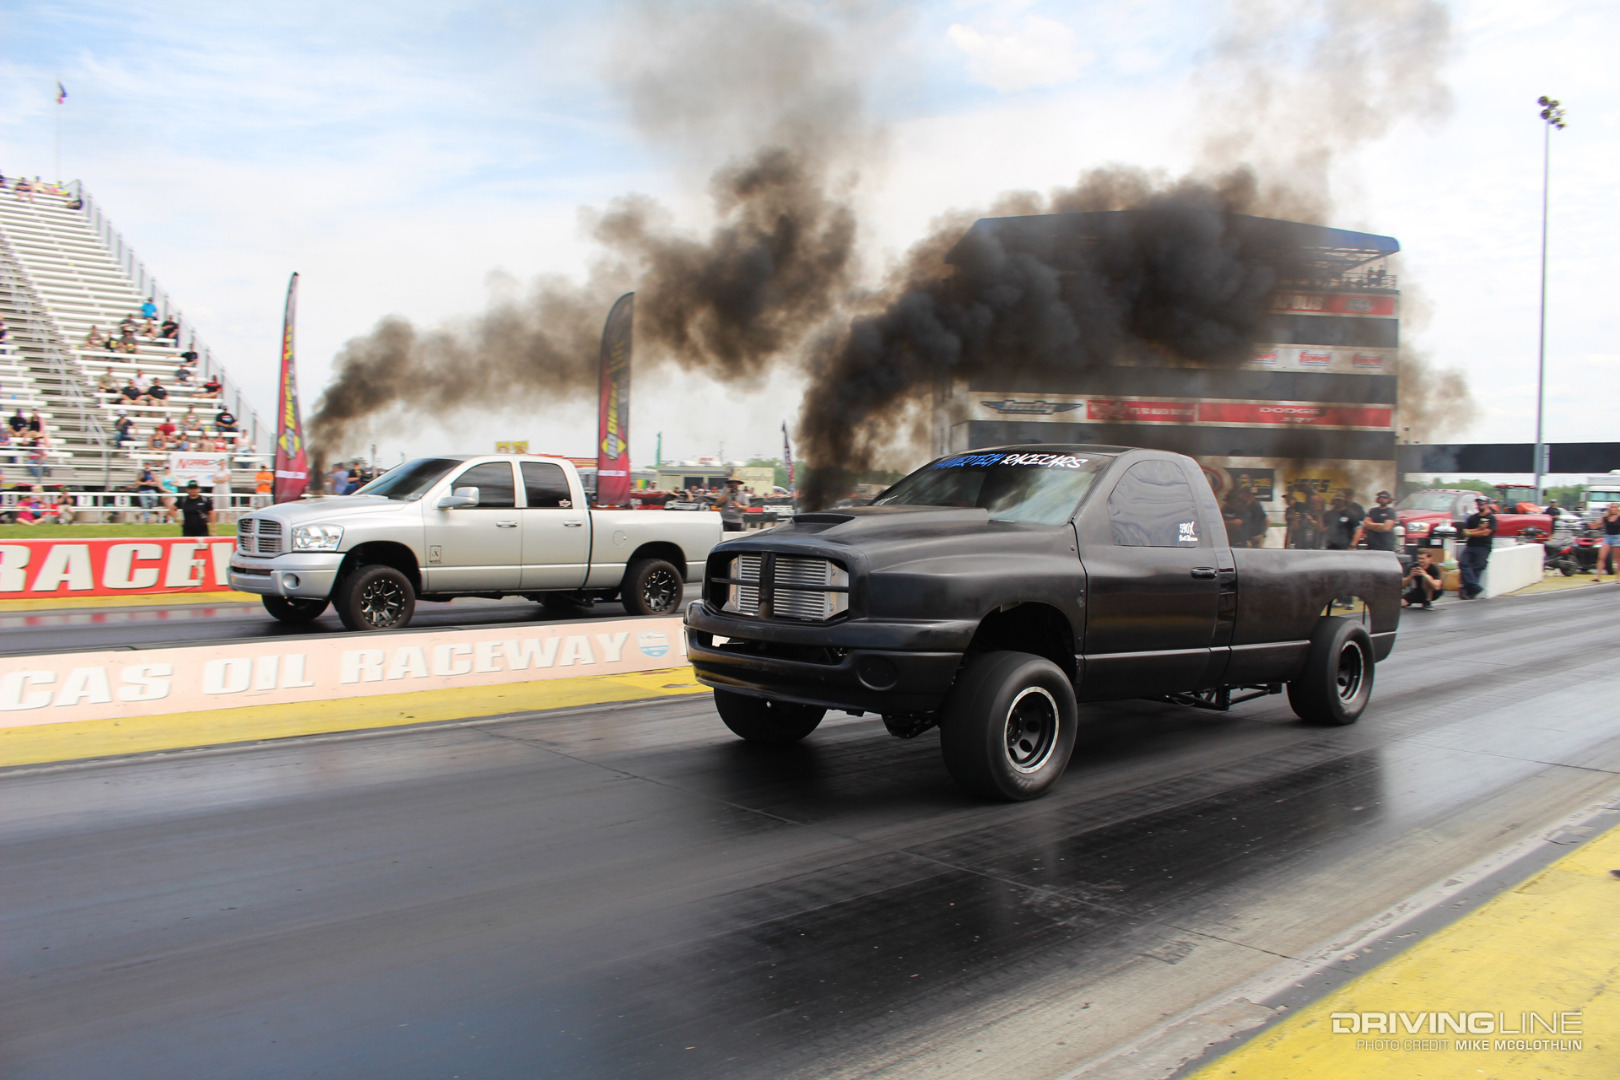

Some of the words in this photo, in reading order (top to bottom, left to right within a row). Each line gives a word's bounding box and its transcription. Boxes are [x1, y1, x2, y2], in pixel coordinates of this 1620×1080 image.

[1000, 454, 1088, 469] RACECARS
[202, 653, 314, 695] OIL
[340, 632, 630, 684] RACEWAY
